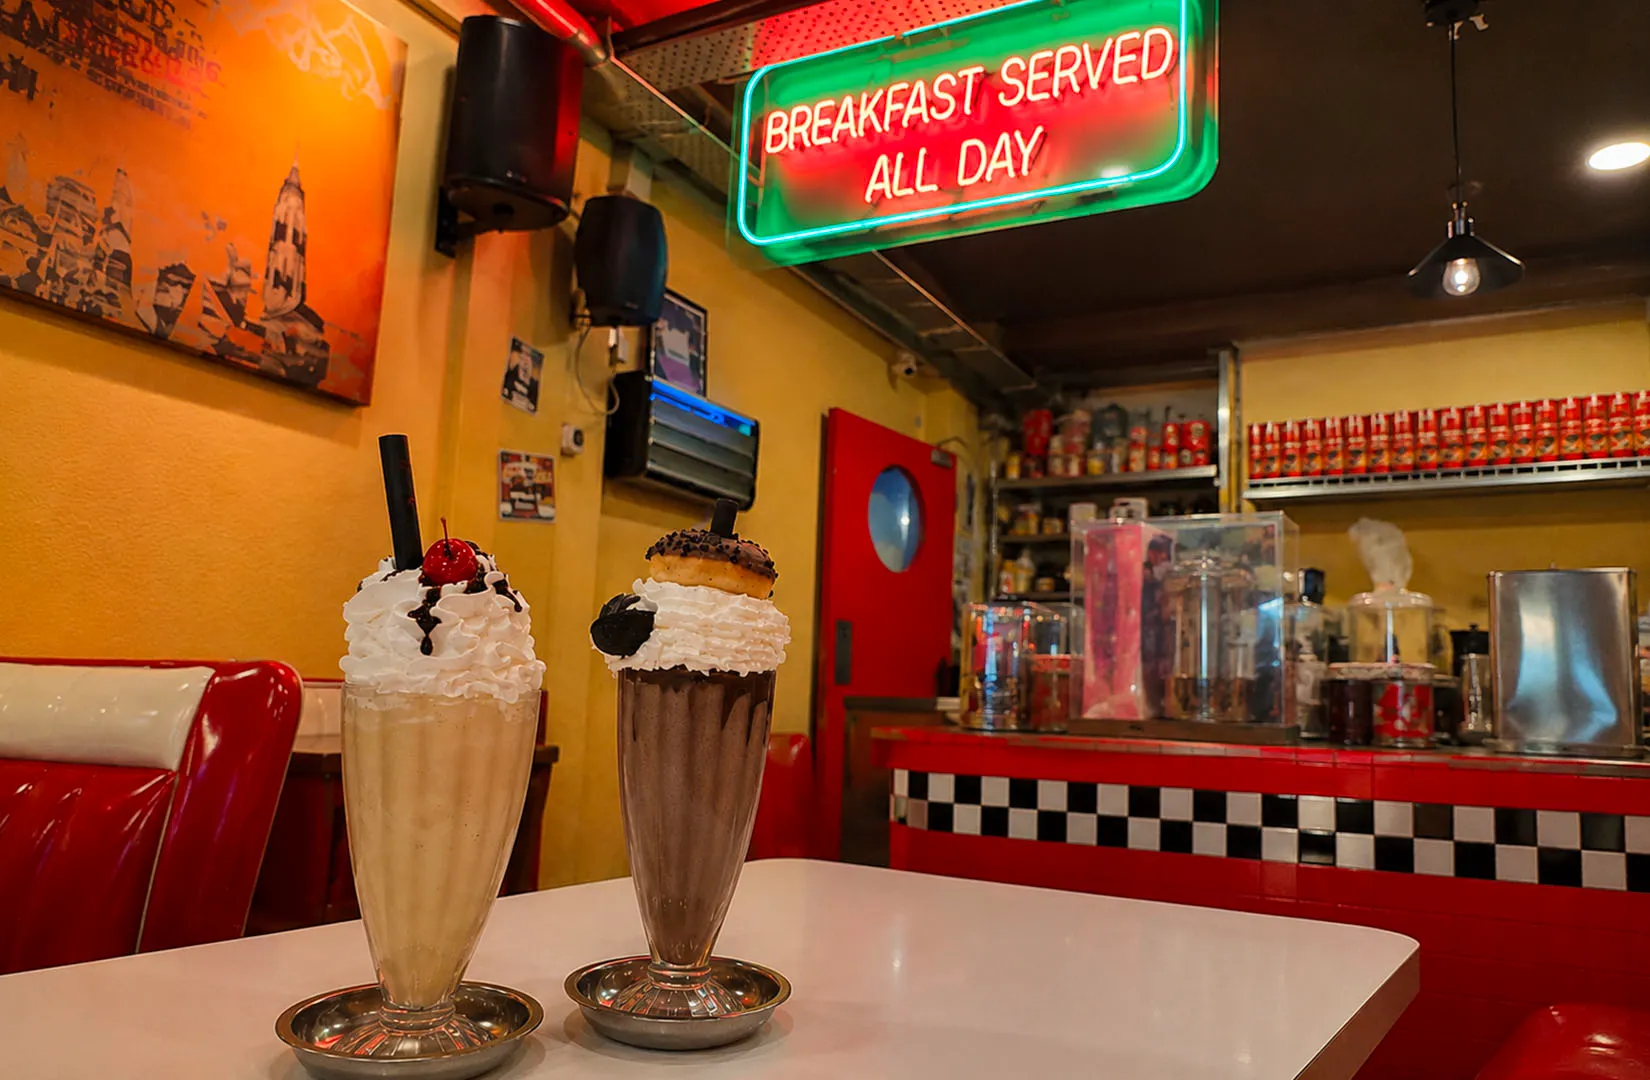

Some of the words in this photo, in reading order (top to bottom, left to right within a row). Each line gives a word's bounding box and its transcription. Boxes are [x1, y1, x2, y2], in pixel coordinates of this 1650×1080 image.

[764, 65, 985, 154] BREAKFAST
[997, 27, 1174, 107] SERVED
[864, 147, 939, 203] ALL
[957, 126, 1044, 187] DAY
